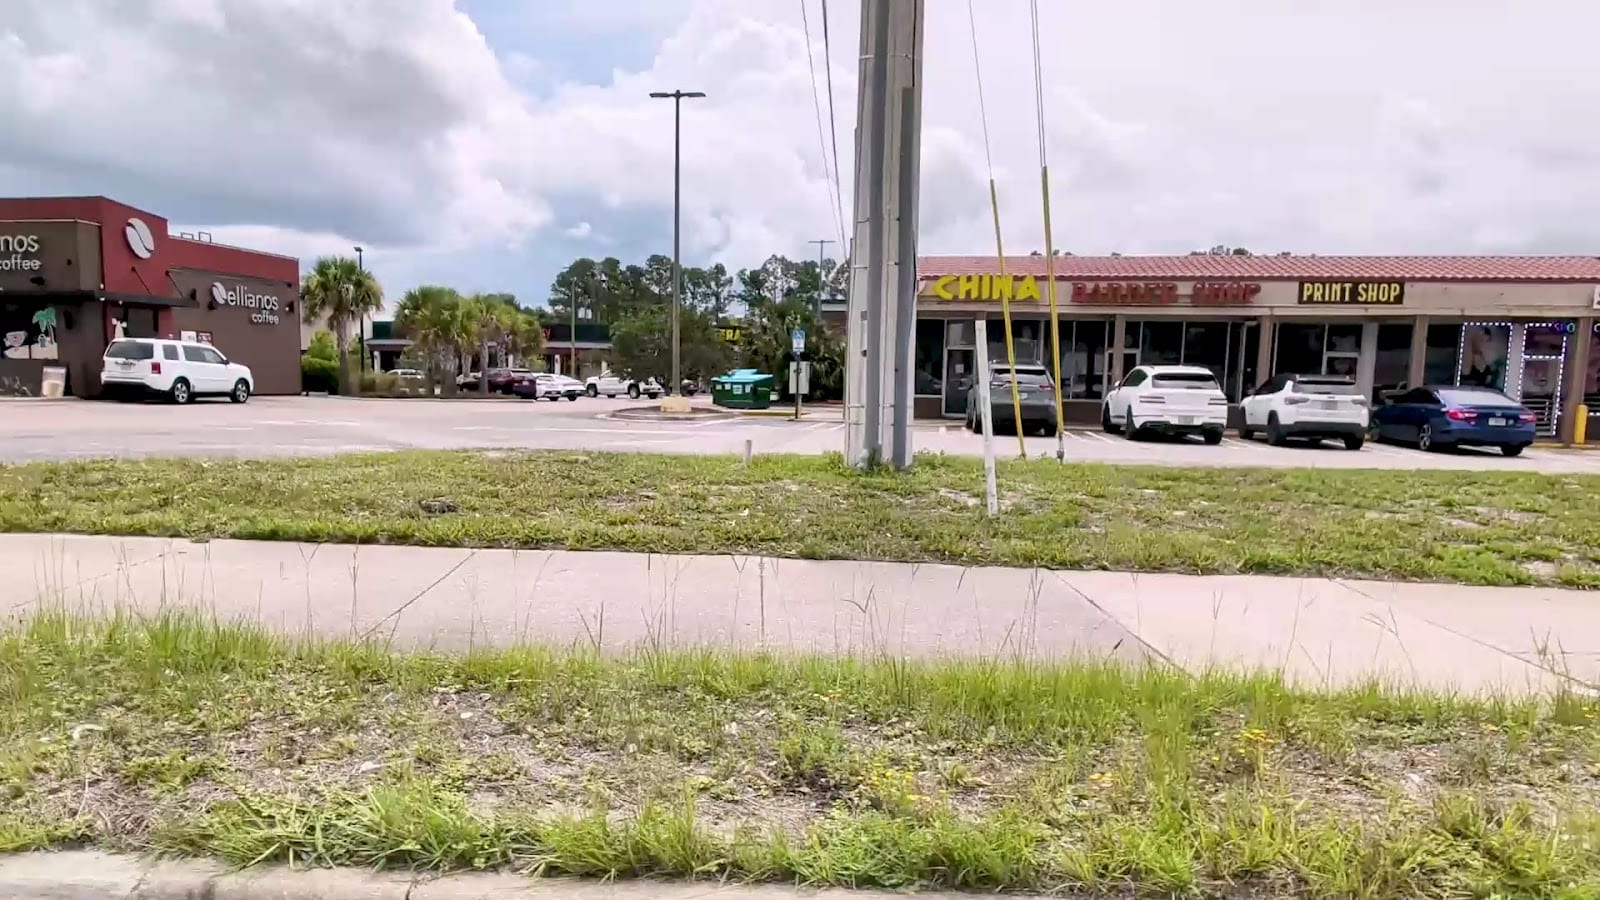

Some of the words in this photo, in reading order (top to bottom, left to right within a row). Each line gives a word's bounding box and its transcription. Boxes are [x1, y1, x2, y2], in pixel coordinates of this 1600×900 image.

[0, 254, 40, 270] offee
[935, 273, 1040, 300] CHINA
[1070, 282, 1179, 303] BARBER
[1192, 281, 1261, 304] SHOP
[1302, 283, 1352, 302] PRINT
[1357, 283, 1401, 302] SHOP
[227, 285, 279, 310] ellianos
[251, 310, 279, 325] coffee
